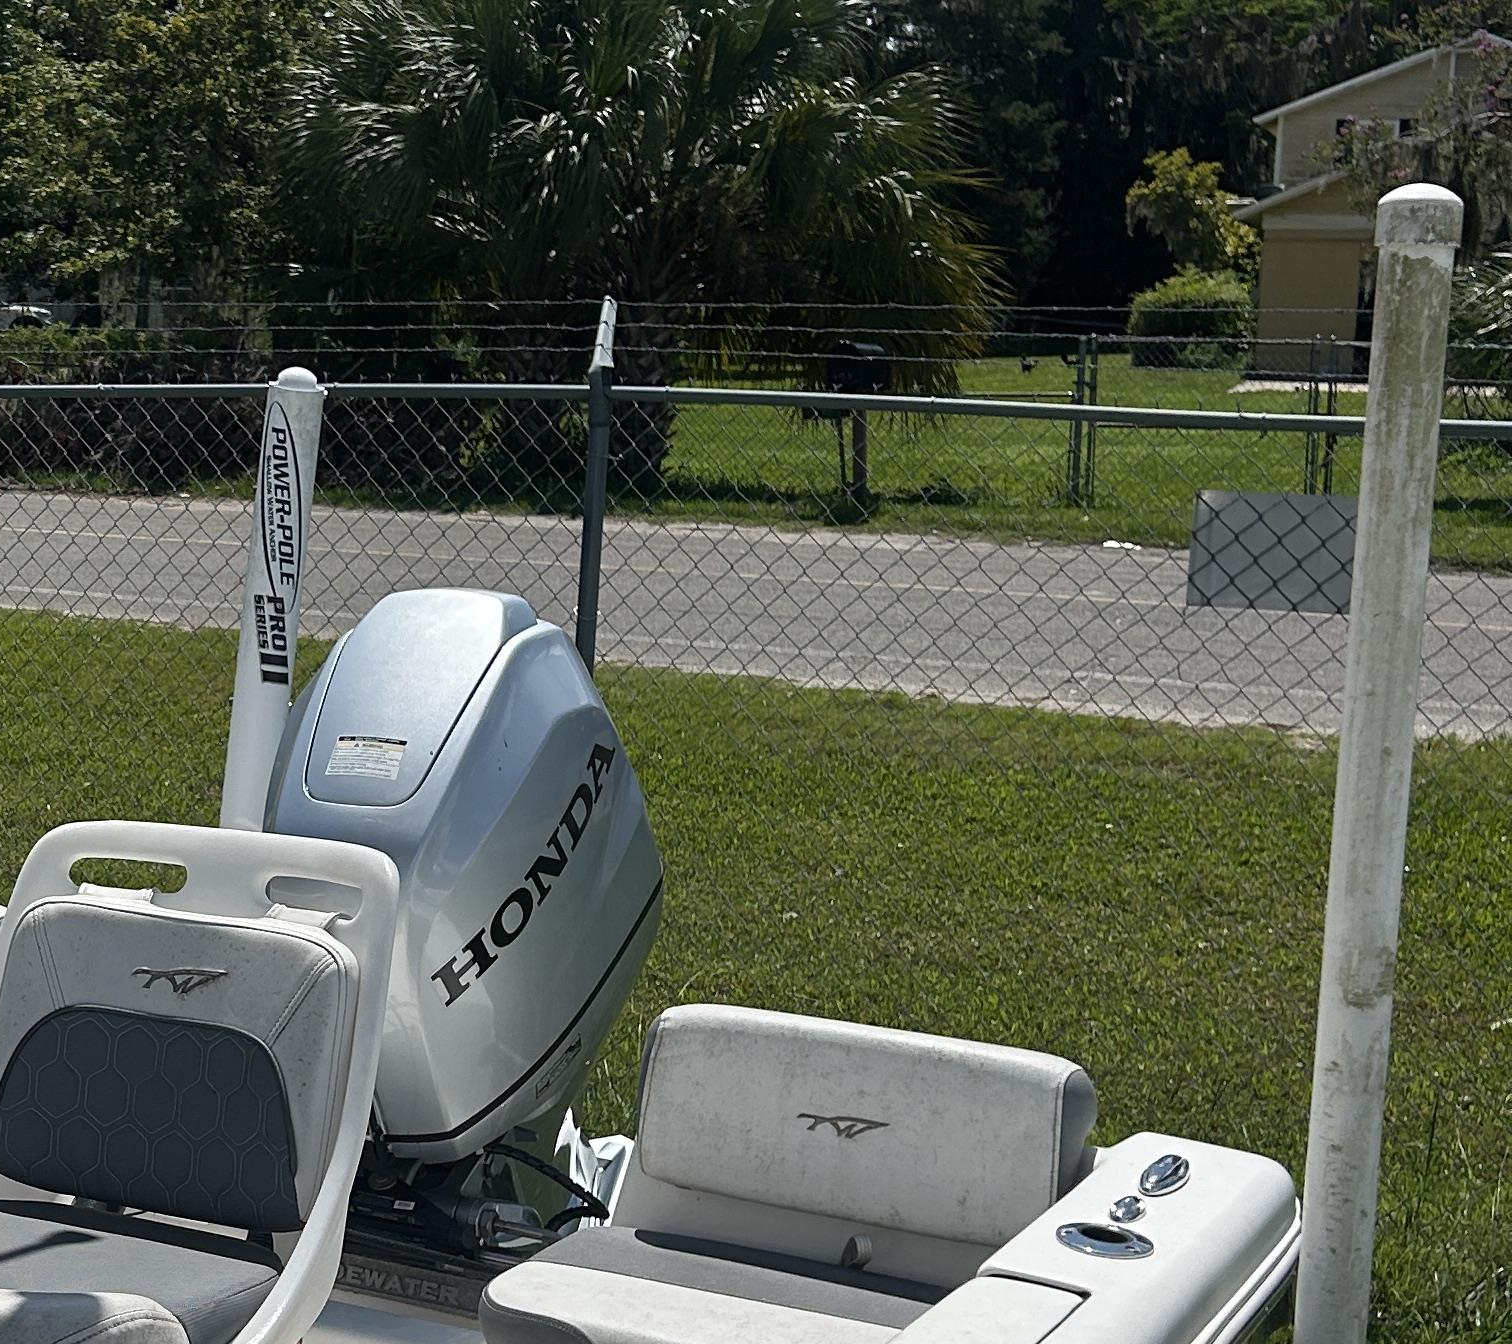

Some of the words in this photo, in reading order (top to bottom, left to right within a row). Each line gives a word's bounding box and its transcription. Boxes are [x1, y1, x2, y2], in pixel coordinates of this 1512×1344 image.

[271, 426, 295, 591] POWER-POLE
[253, 594, 270, 650] SERIES
[266, 595, 288, 652] PRO
[428, 741, 616, 1008] HONDA
